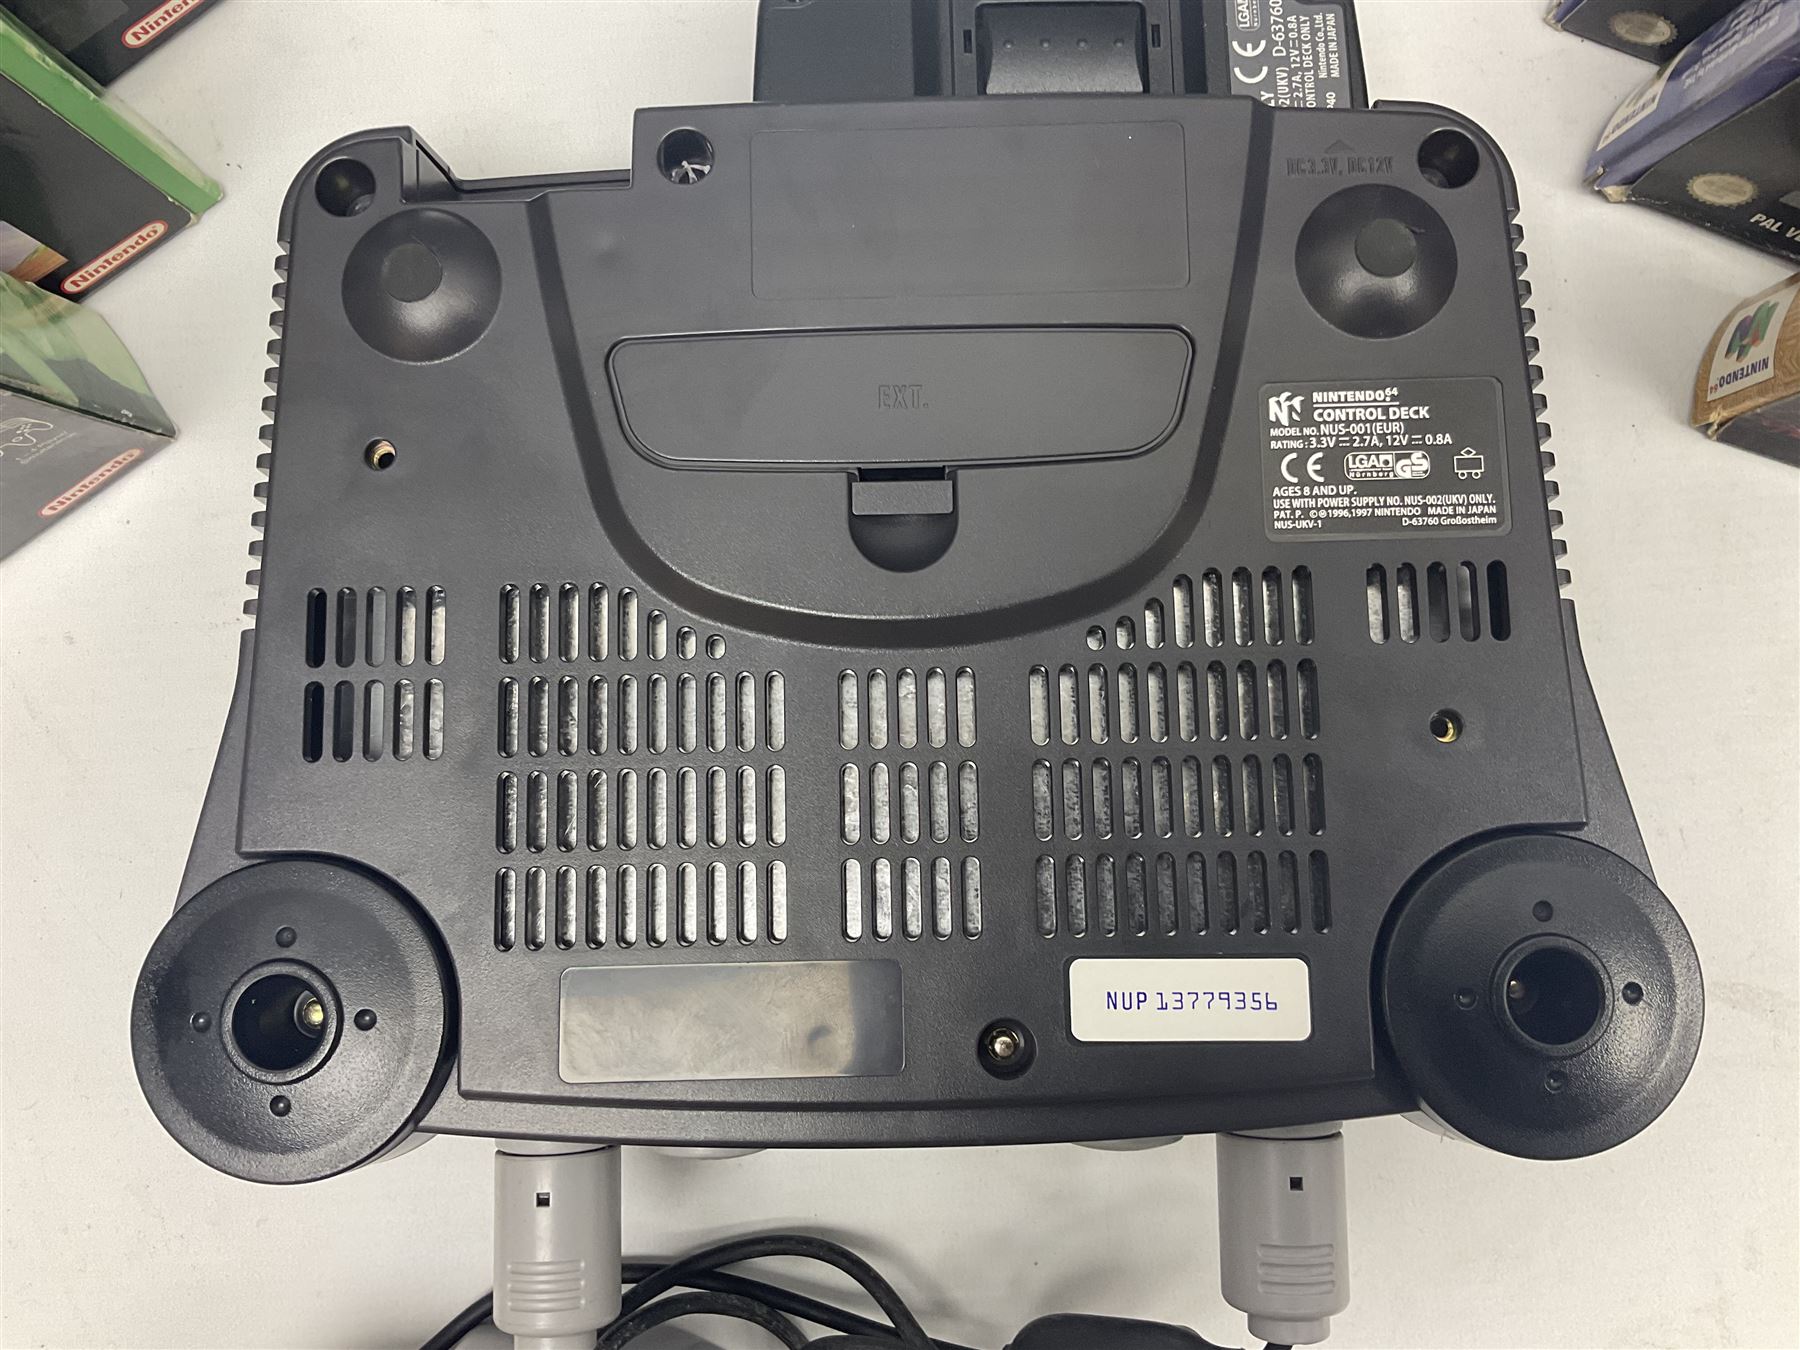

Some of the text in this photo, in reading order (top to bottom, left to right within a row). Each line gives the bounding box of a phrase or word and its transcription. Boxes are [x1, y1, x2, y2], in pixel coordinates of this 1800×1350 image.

[1287, 15, 1298, 39] 0.8A
[1299, 15, 1311, 41] ONLY
[1301, 42, 1314, 68] DECK
[1326, 13, 1340, 78] MADE IN JAPAN
[1315, 43, 1328, 79] Nintendo
[1276, 67, 1290, 108] 2(UKV)
[1749, 213, 1783, 232] PAL
[69, 226, 159, 289] Nintendo
[878, 384, 929, 409] EXT.
[1313, 406, 1430, 422] CONTROL DECK
[1270, 421, 1404, 437] MODEL NO. NUS-001(EUR)
[1309, 436, 1336, 449] 3.3V
[1352, 435, 1383, 448] 2.7A,
[1386, 434, 1409, 446] 12V
[1425, 433, 1453, 445] 0.8A
[1272, 484, 1358, 497] AGES 8 AND UP.
[1273, 493, 1496, 509] USE WITH POWER SUPPLY NO. NUS-002(UKV) ONLY.
[1273, 510, 1294, 519] PAT.
[1295, 510, 1304, 518] P.
[1374, 507, 1421, 517] NINTENDO
[1427, 505, 1454, 515] MADE
[1456, 506, 1466, 514] IN
[1467, 505, 1497, 514] JAPAN
[1274, 515, 1497, 529] NUS-UKV-1 D-63760 Großostheim
[1106, 991, 1278, 1011] NUP 13779356
